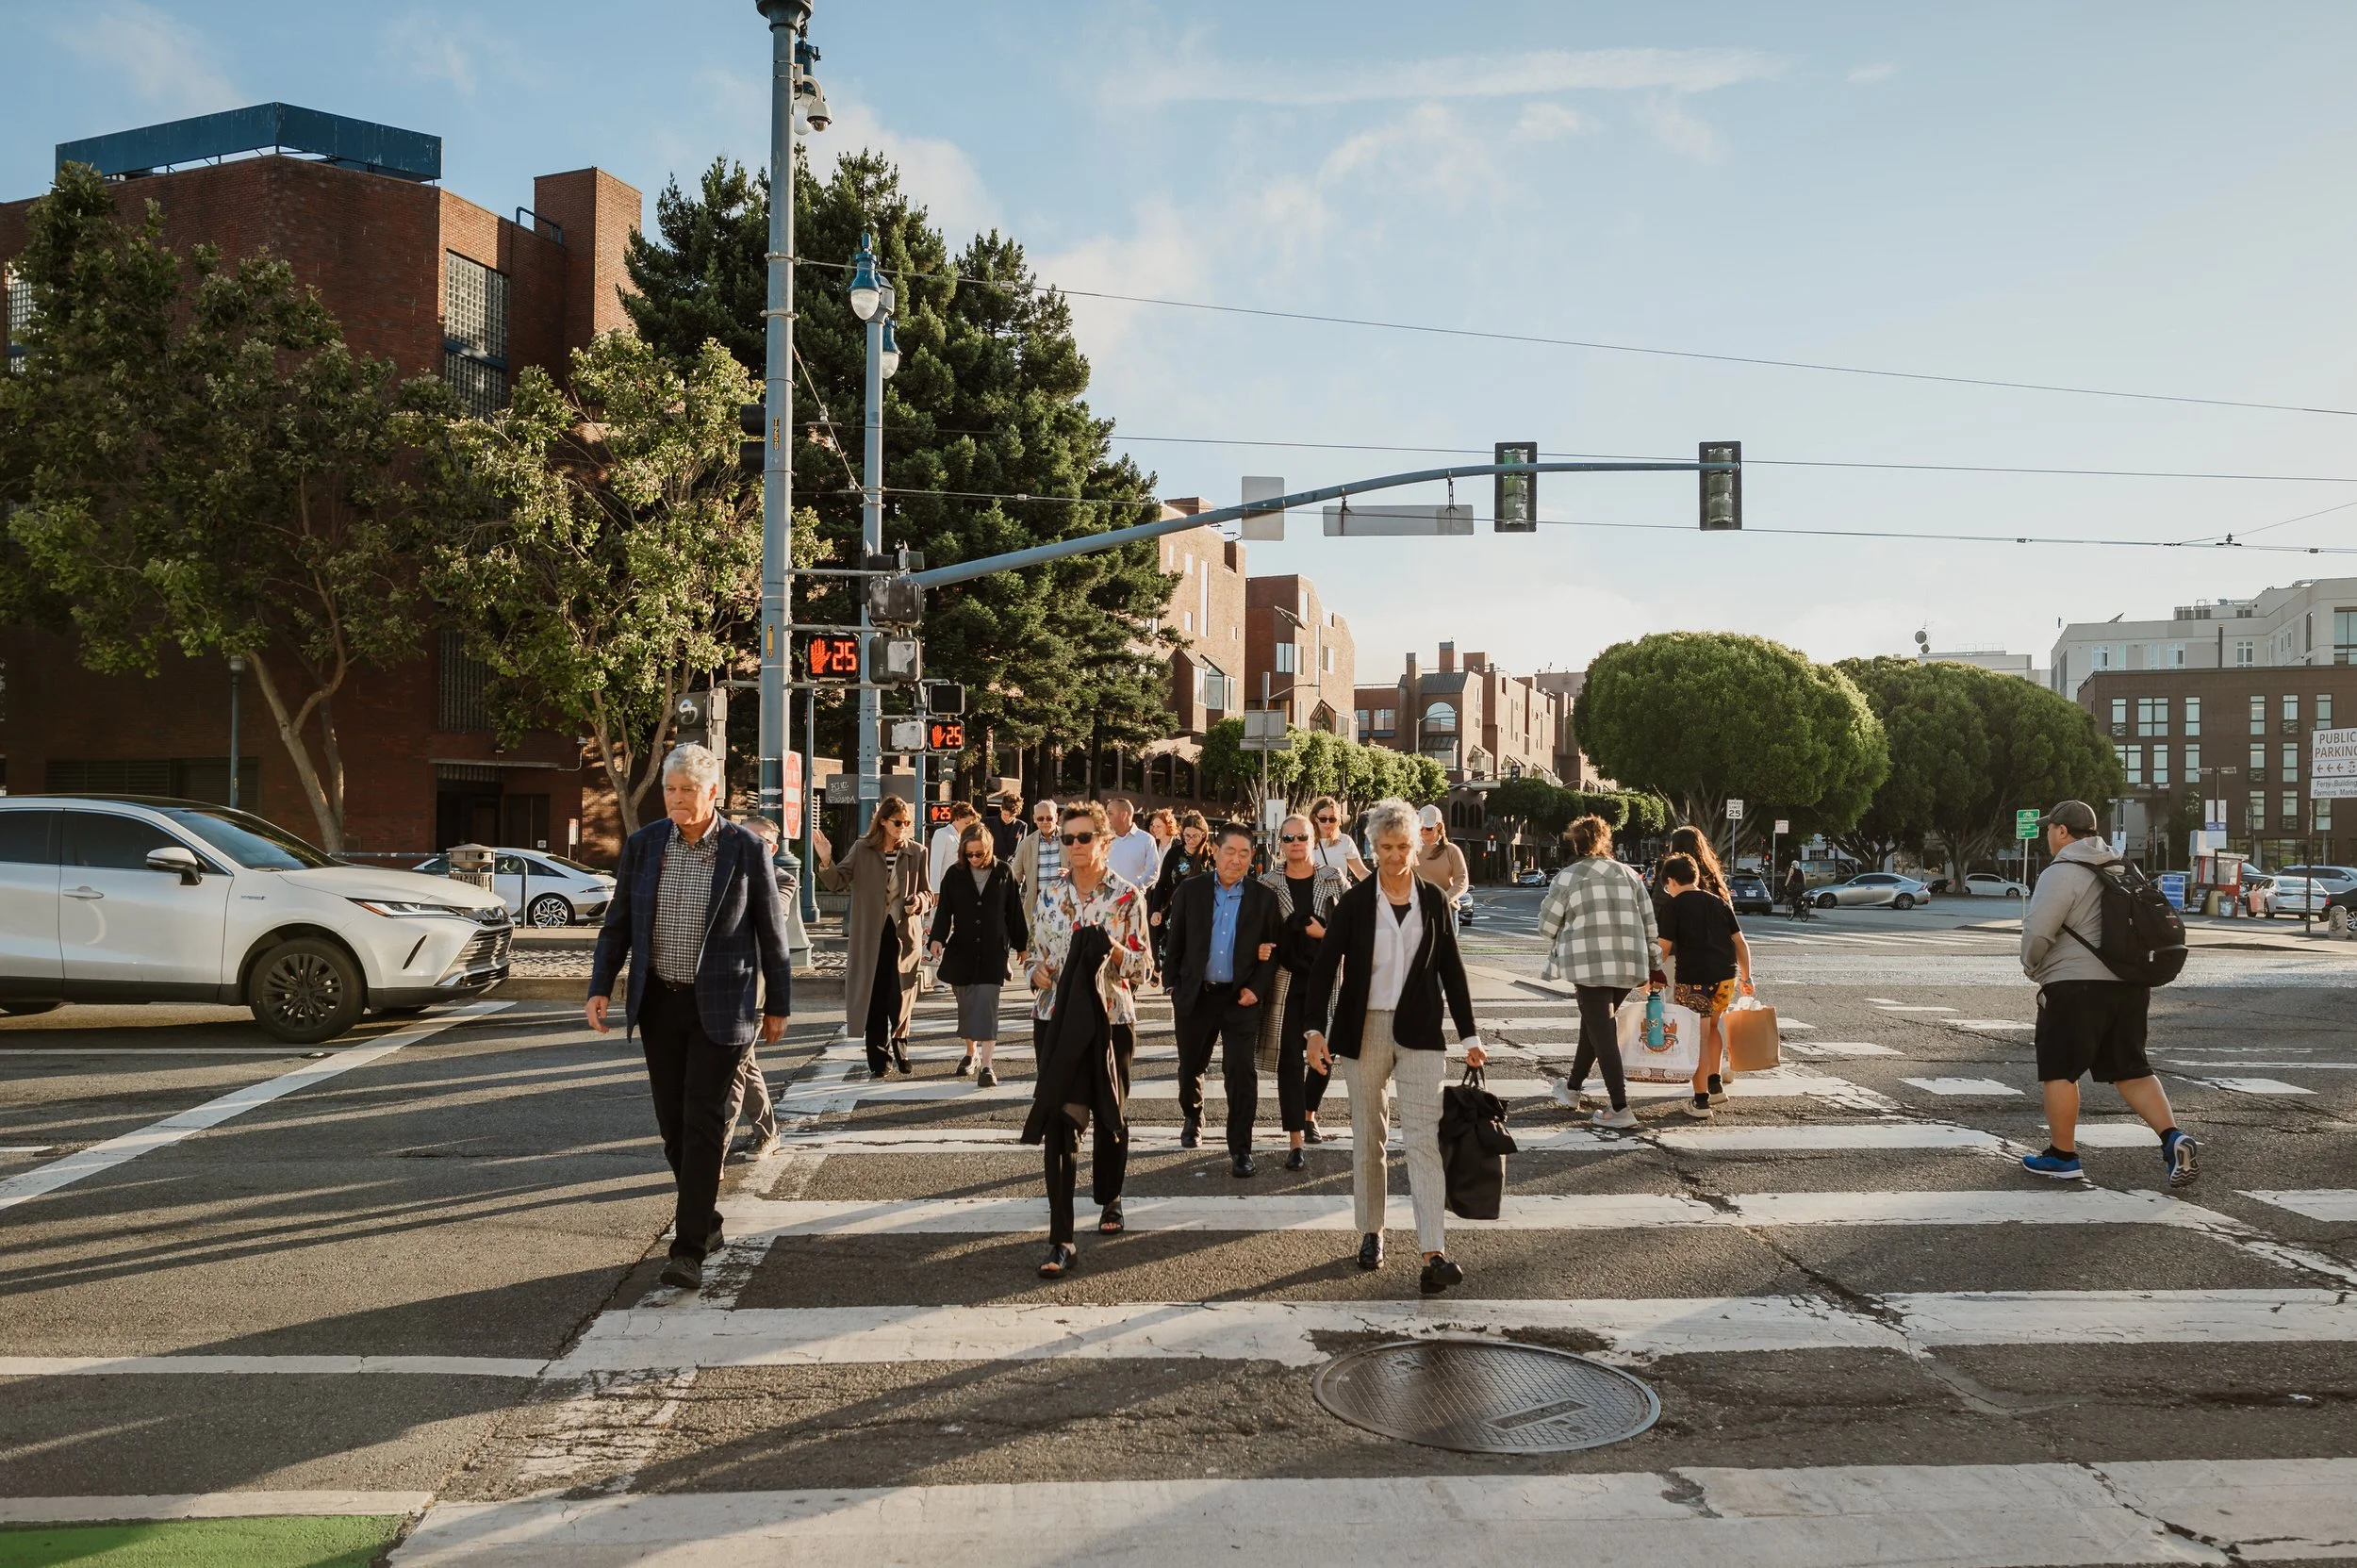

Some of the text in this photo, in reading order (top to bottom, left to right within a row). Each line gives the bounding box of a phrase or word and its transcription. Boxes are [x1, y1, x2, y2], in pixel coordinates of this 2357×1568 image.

[832, 641, 856, 670] 25
[946, 726, 962, 745] 25
[2319, 731, 2357, 745] PUBLIC
[940, 807, 951, 819] 25
[1728, 809, 1741, 817] 25
